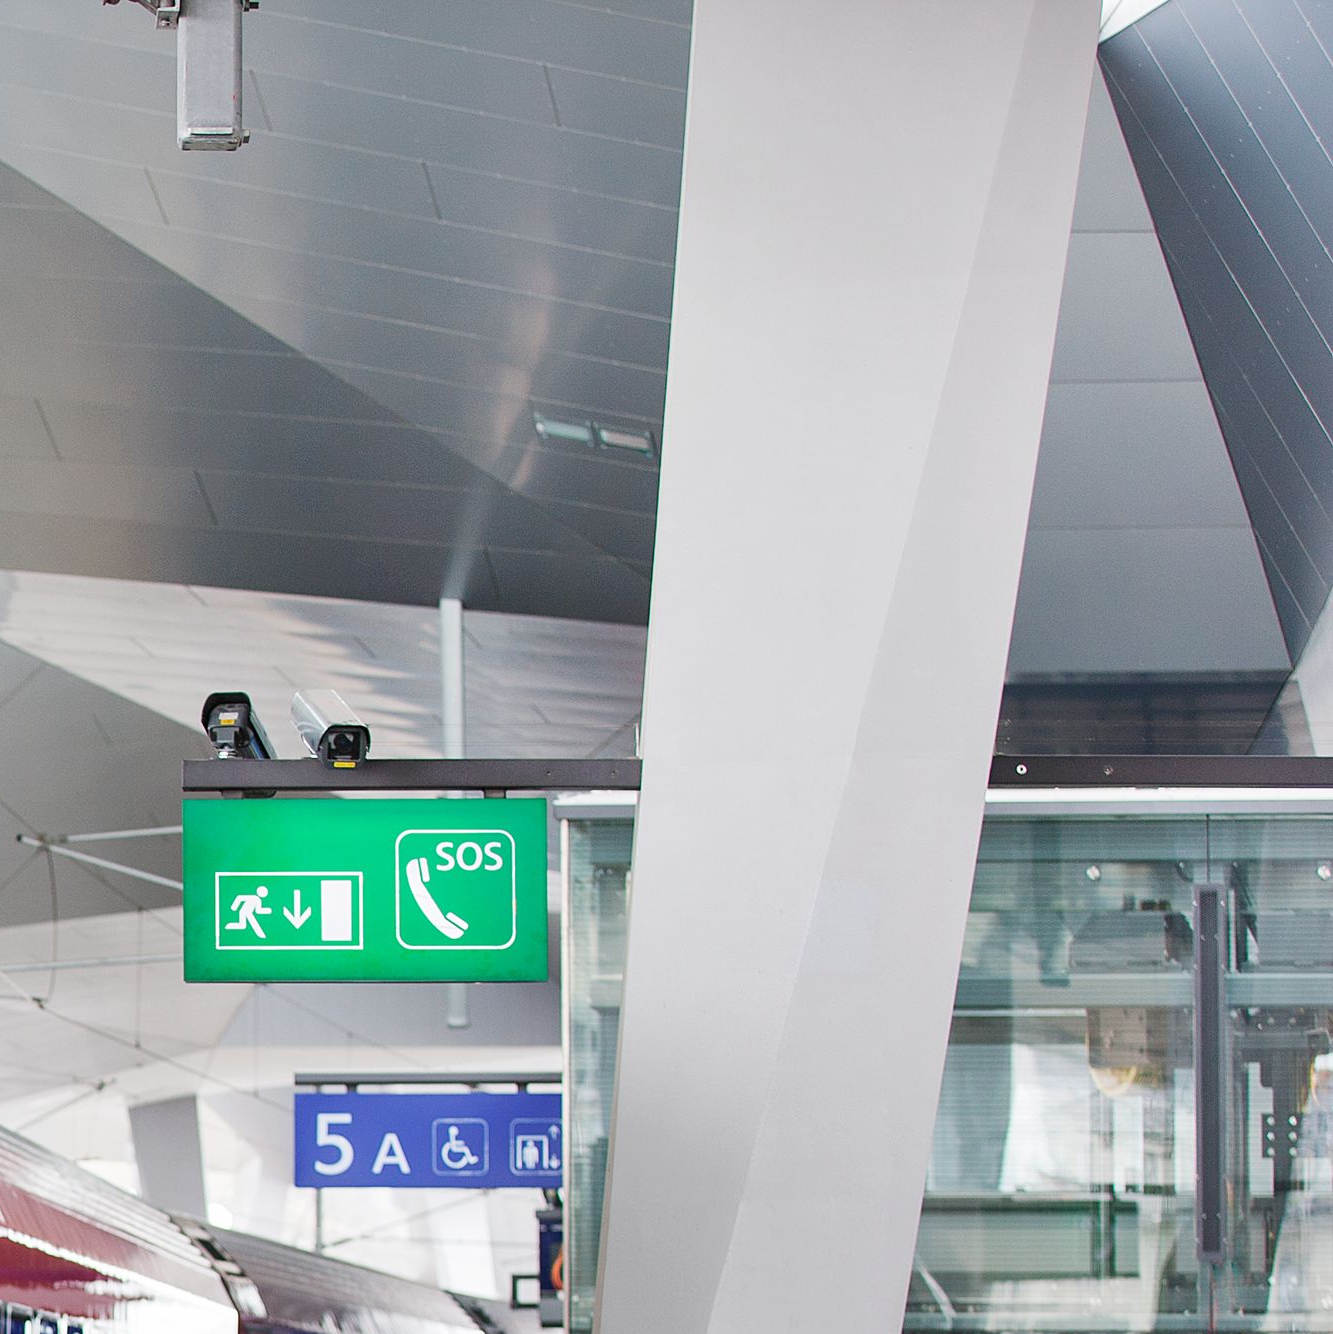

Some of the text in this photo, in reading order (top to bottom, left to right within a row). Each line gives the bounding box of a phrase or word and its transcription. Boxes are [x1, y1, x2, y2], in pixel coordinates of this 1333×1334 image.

[435, 840, 504, 873] SOS
[313, 1112, 412, 1176] 5 A
